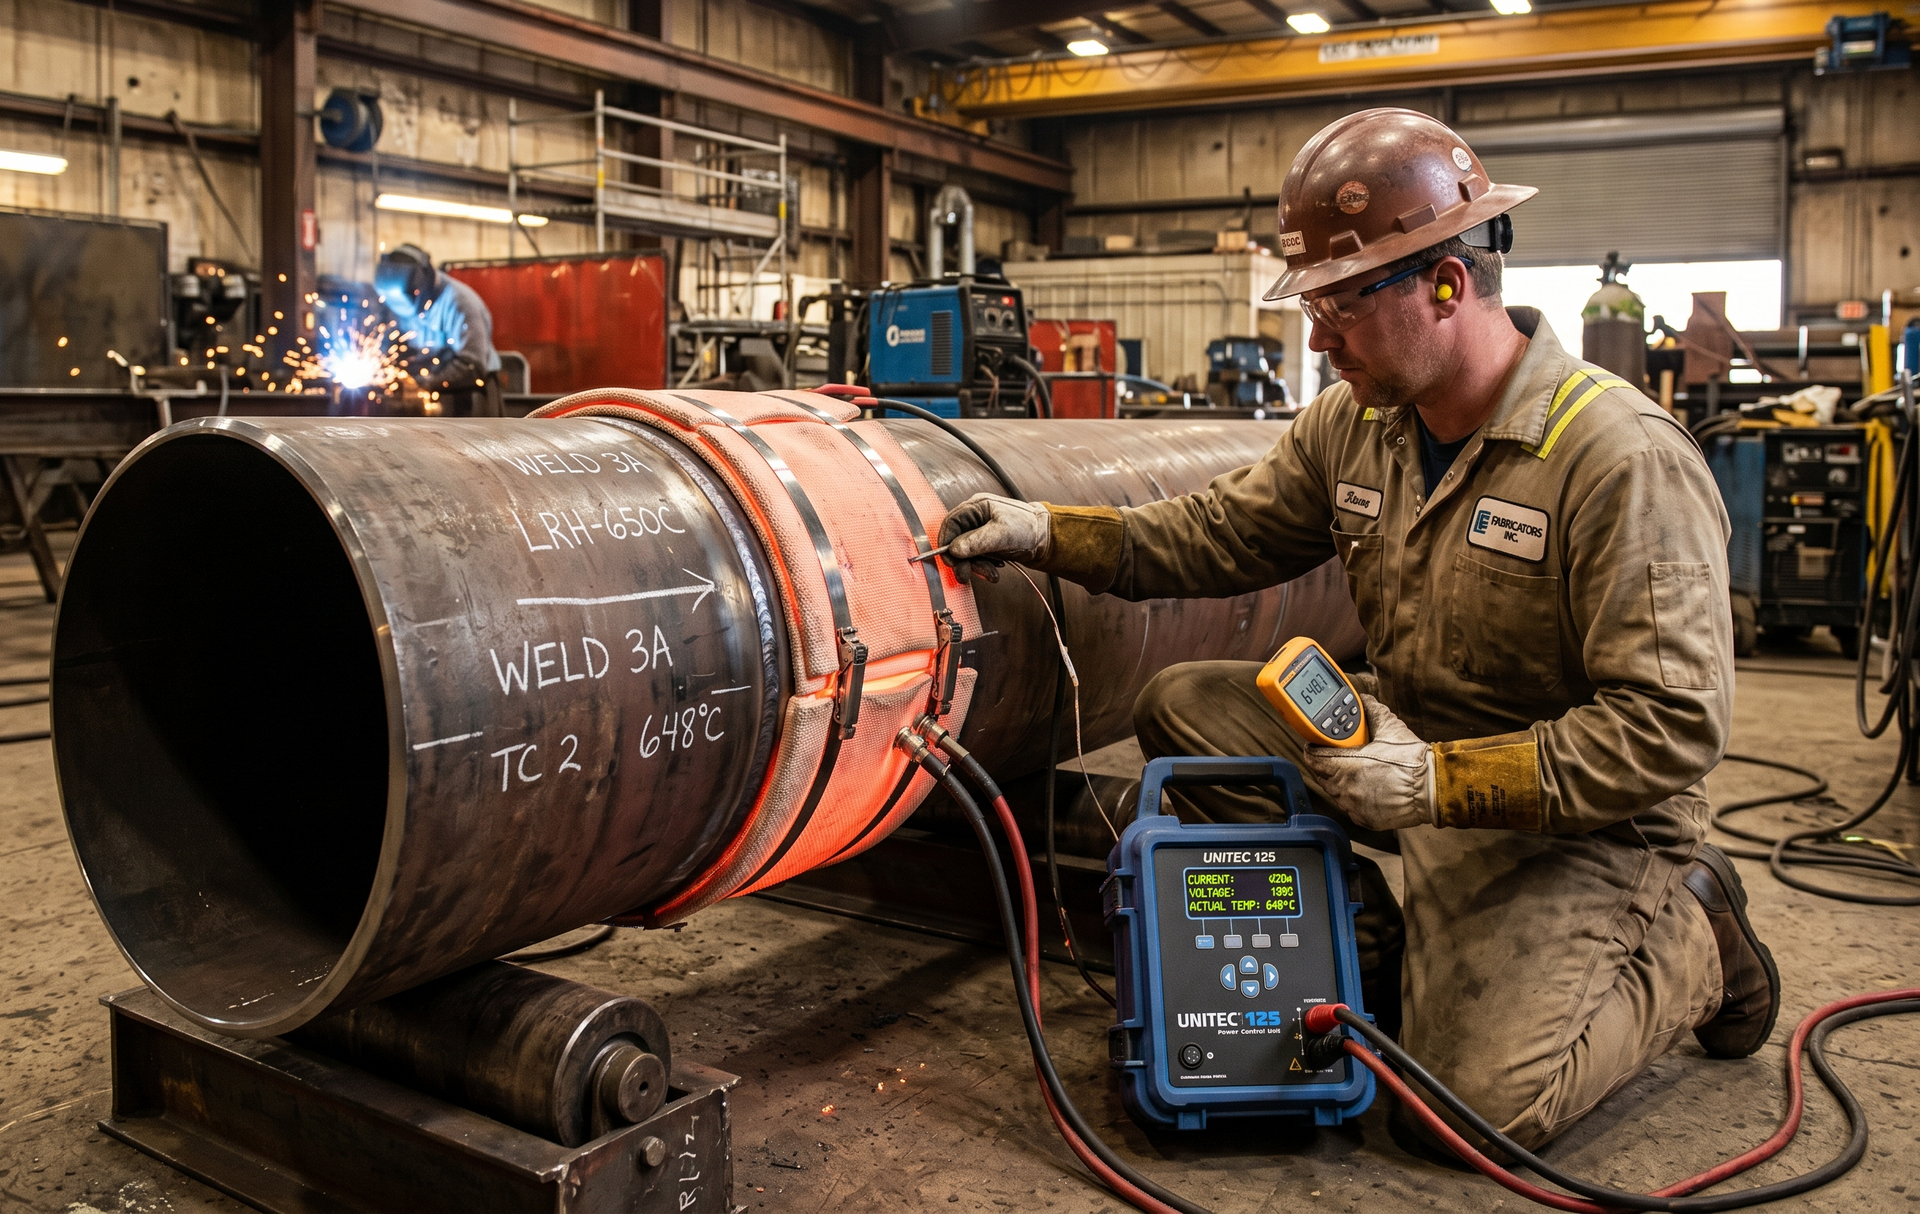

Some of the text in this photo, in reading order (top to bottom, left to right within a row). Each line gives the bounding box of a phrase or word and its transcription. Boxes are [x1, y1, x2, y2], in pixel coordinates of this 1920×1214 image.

[504, 453, 652, 476] WELD 3A
[511, 506, 685, 552] LRH-650C
[1491, 515, 1543, 538] FABRICATORS
[1503, 530, 1519, 543] INC.
[490, 624, 674, 695] WELD 3A
[640, 704, 725, 758] 648°C
[491, 734, 582, 792] TC 2
[1203, 851, 1276, 863] UNITEC 125
[1187, 874, 1234, 885] CURRENT:
[1188, 887, 1235, 898] VOLTAGE:
[1189, 899, 1296, 912] ACTUAL TEMP: 648°C
[1177, 1010, 1281, 1028] UNITEC 125
